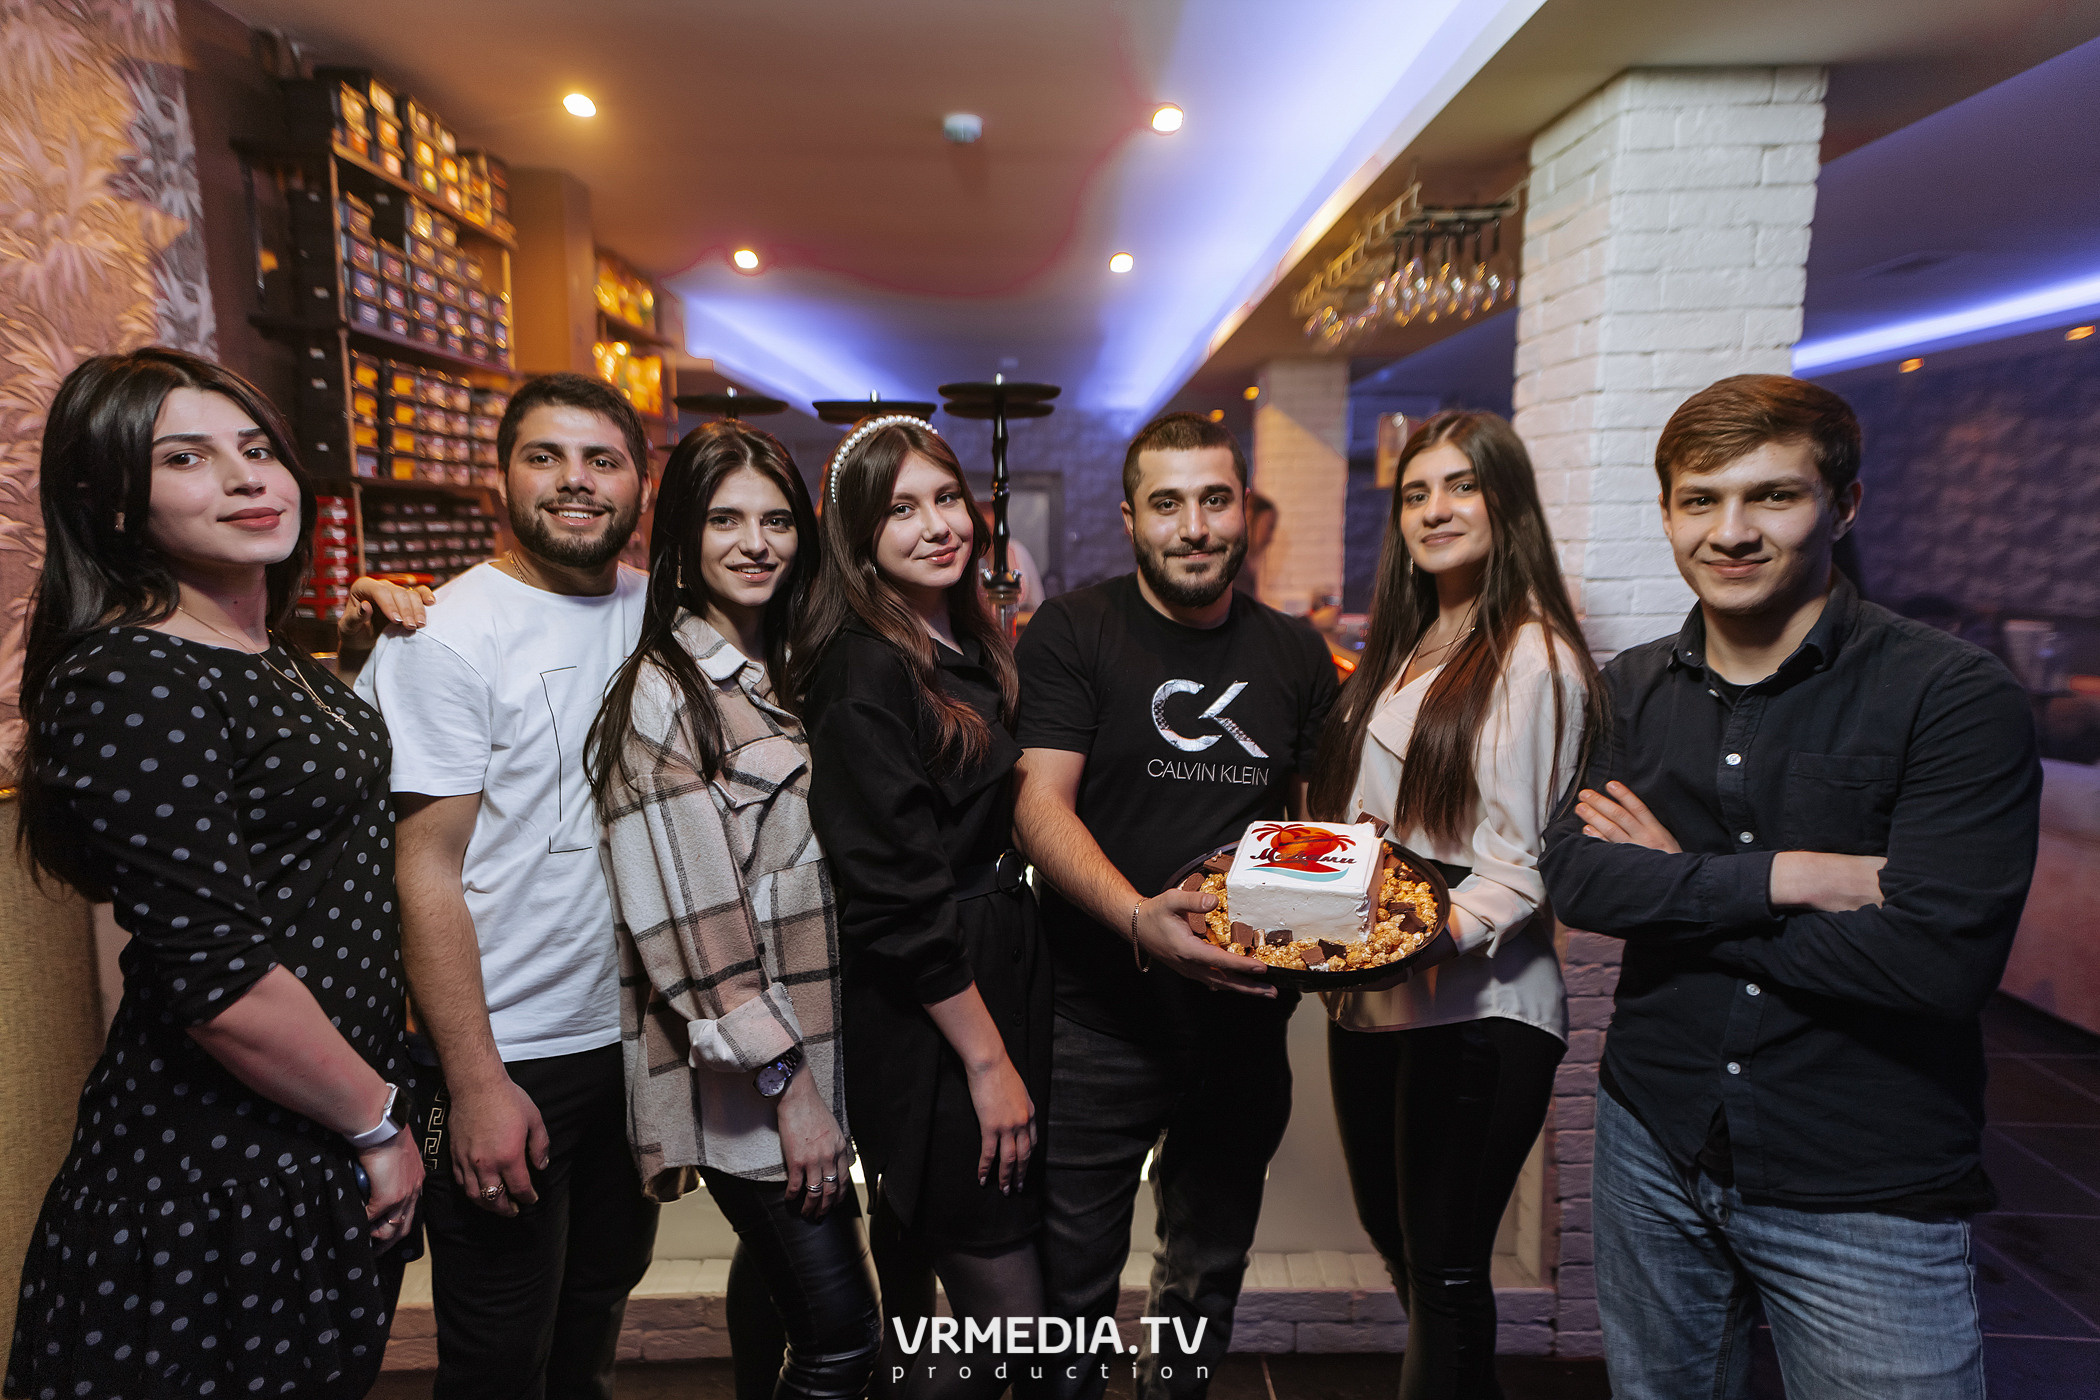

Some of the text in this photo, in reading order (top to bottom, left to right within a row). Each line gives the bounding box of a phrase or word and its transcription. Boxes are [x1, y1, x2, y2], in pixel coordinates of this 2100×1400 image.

[1152, 678, 1269, 758] CK
[1147, 759, 1269, 786] CALVIN KLEIN
